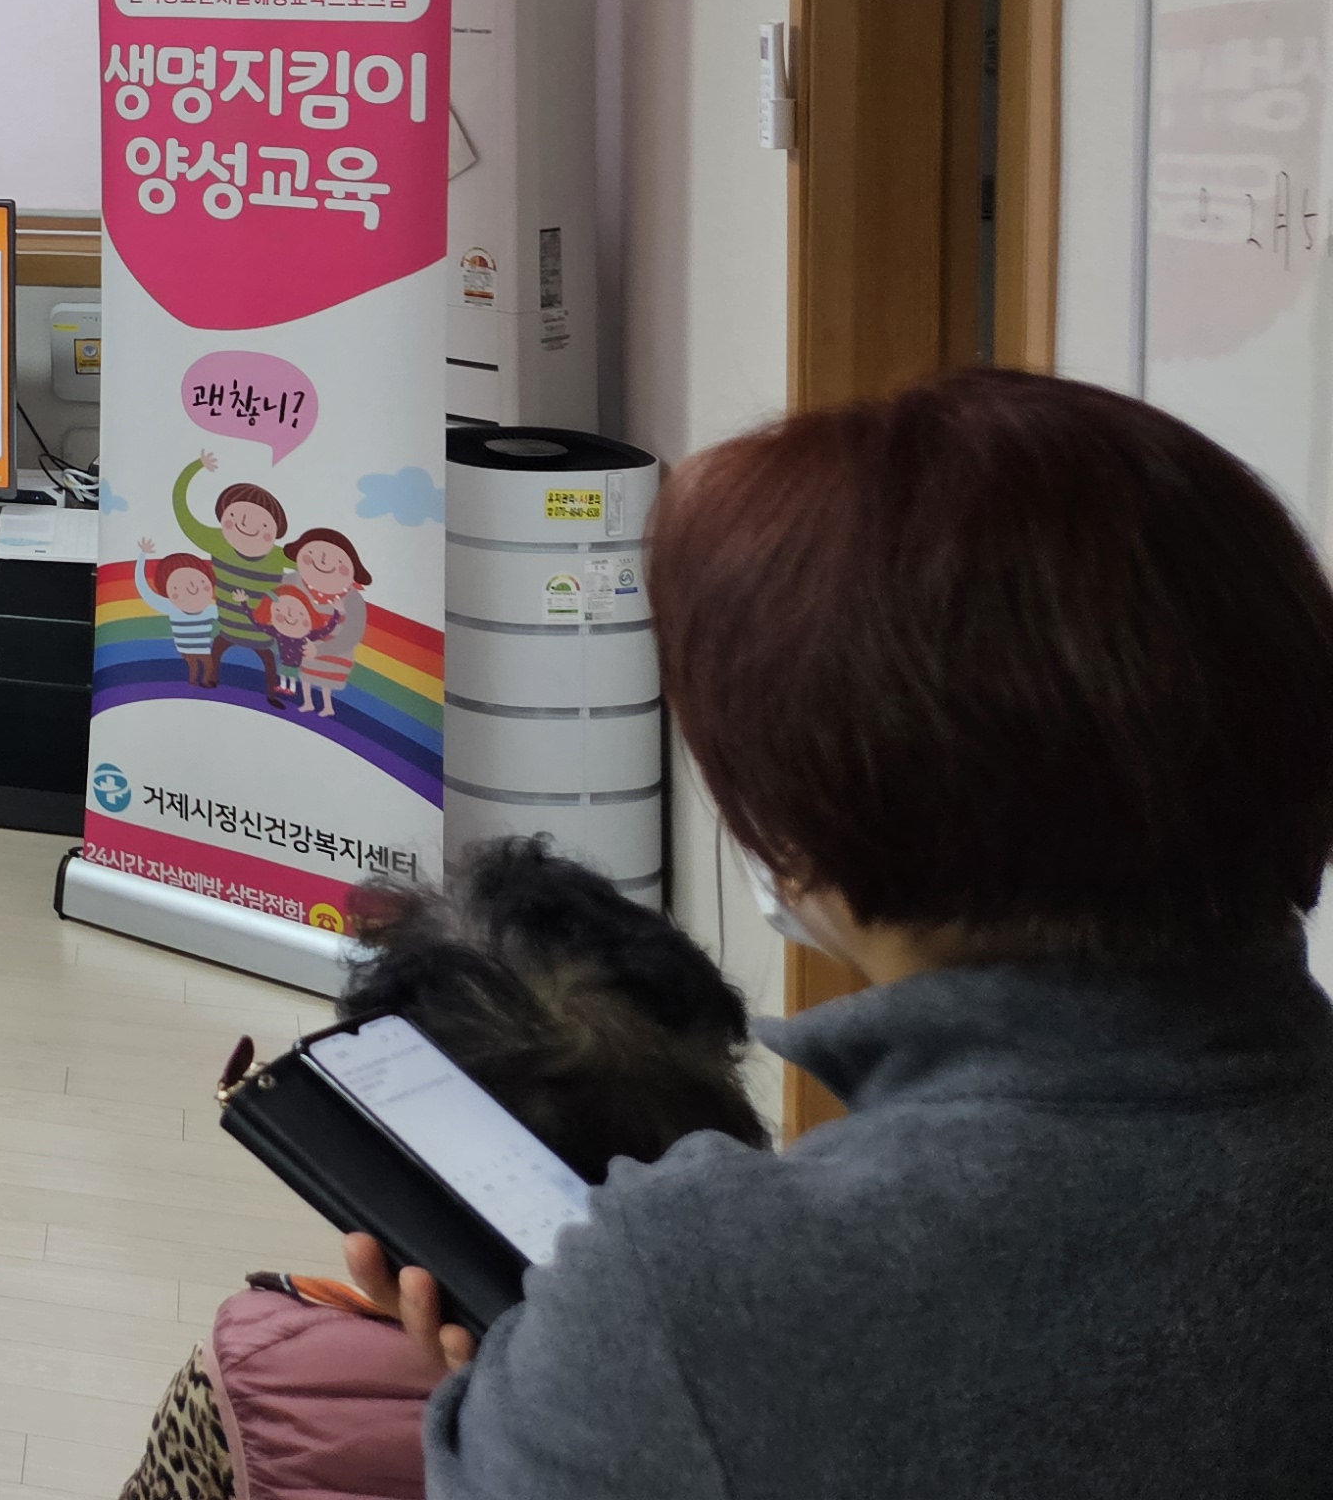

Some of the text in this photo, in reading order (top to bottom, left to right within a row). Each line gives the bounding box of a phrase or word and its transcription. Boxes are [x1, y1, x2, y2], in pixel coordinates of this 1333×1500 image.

[104, 44, 427, 130] 생명지킴이
[125, 137, 390, 231] 양성교육
[192, 379, 305, 429] 괜찮니?
[142, 785, 417, 881] 거제시정신건강복지센터
[86, 841, 306, 923] 24시간 자살예방 상담전화
